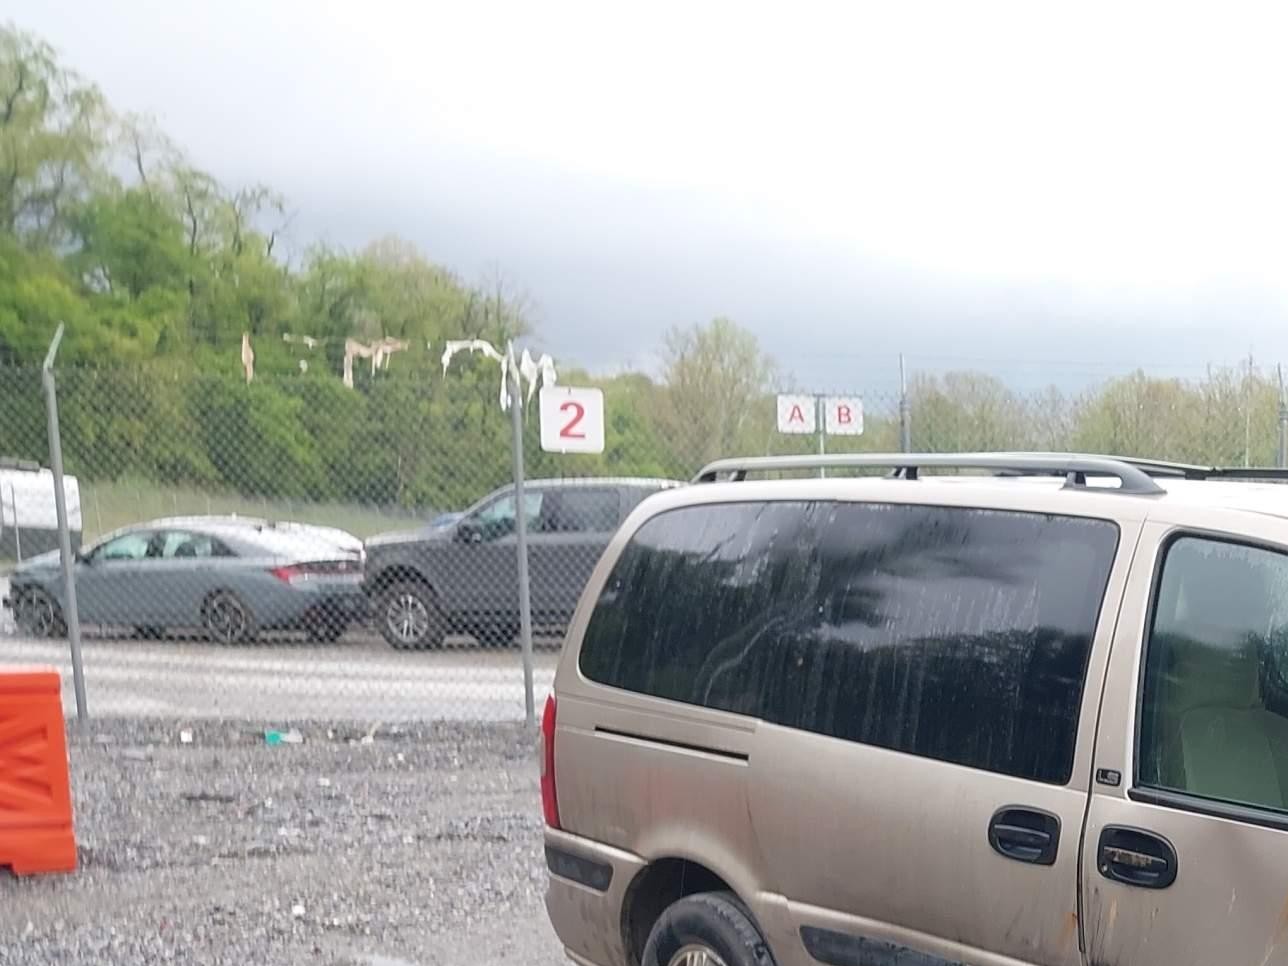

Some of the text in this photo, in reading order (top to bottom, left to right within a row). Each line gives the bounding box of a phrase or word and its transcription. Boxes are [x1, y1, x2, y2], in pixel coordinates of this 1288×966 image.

[559, 401, 585, 439] 2
[789, 404, 805, 423] A
[837, 404, 853, 425] B
